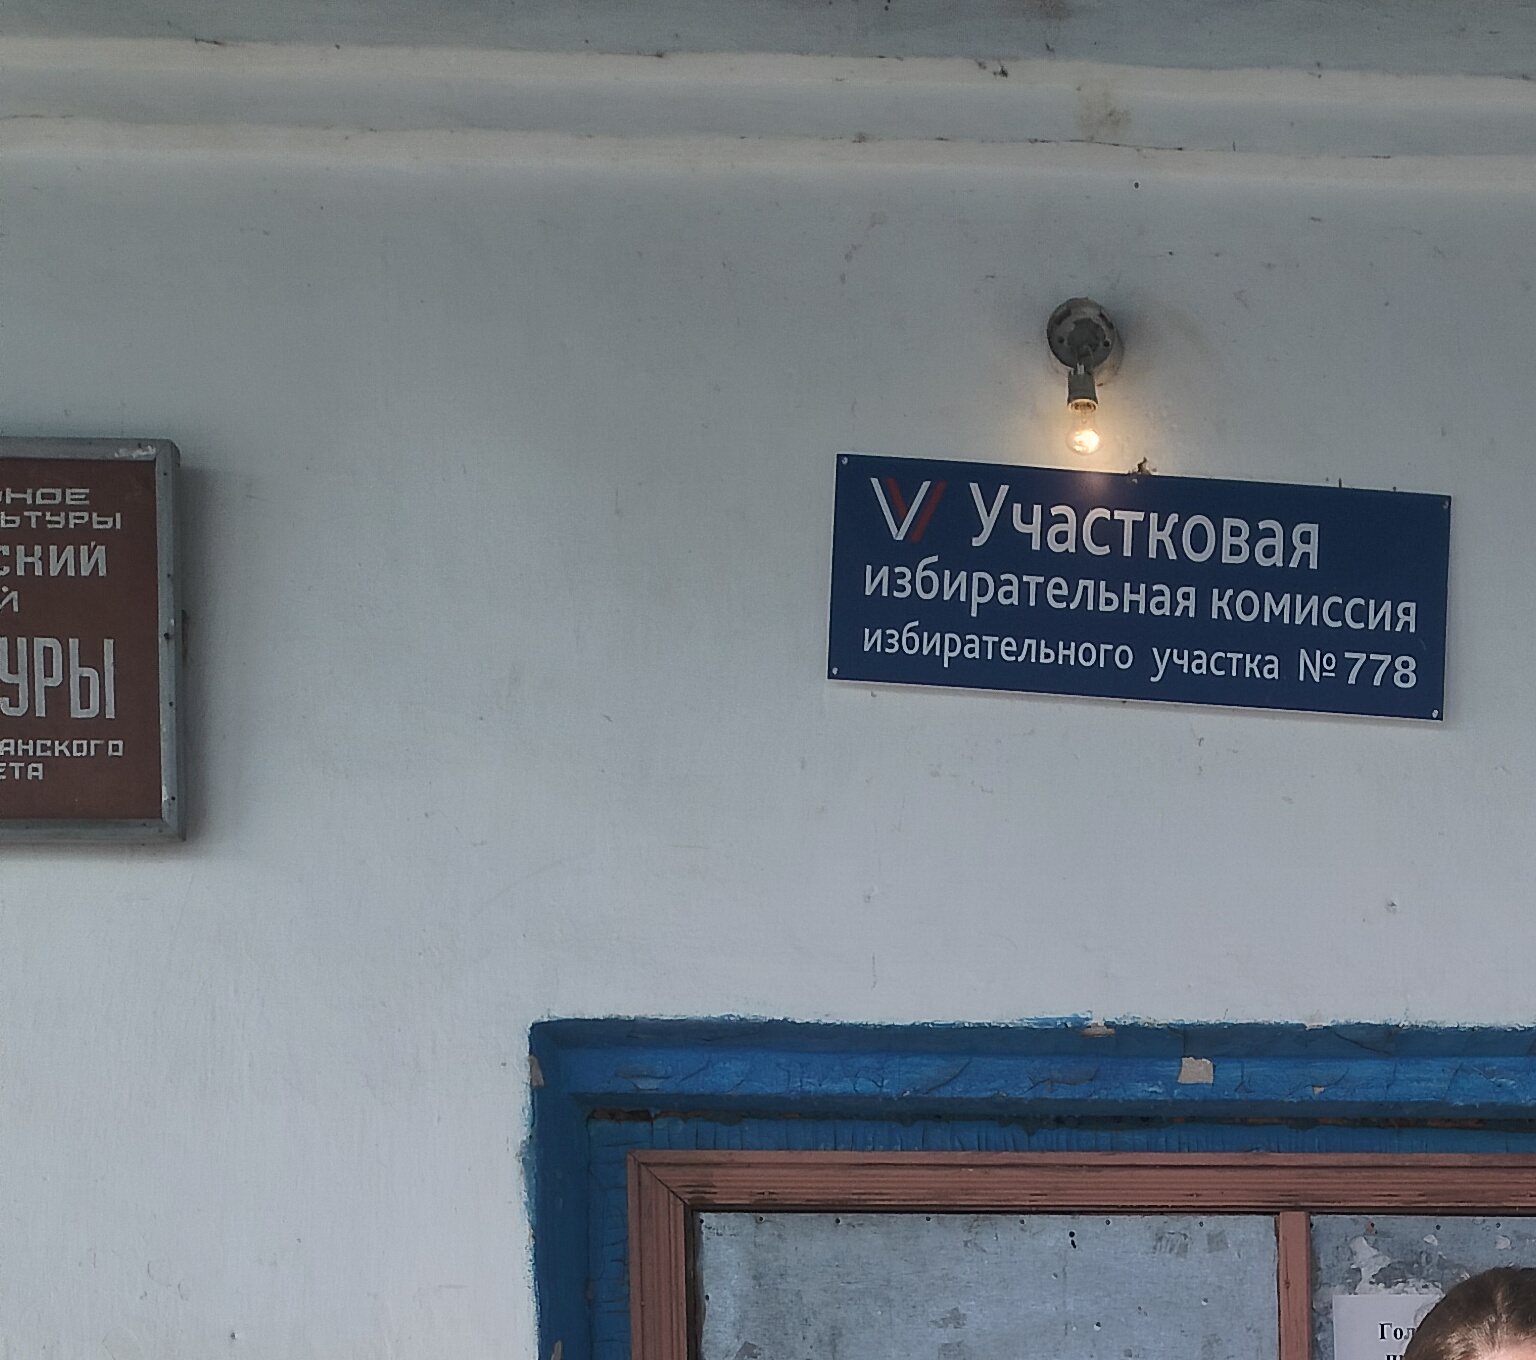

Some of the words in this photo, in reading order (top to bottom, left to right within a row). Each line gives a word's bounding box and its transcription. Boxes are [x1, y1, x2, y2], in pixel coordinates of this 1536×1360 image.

[0, 488, 90, 505] НОЕ
[970, 481, 1320, 570] Участковая
[864, 556, 1196, 618] избирательная
[1210, 586, 1418, 634] комиссия
[0, 636, 116, 719] УРЫ
[862, 620, 1134, 671] избирательного
[1150, 645, 1279, 682] участка
